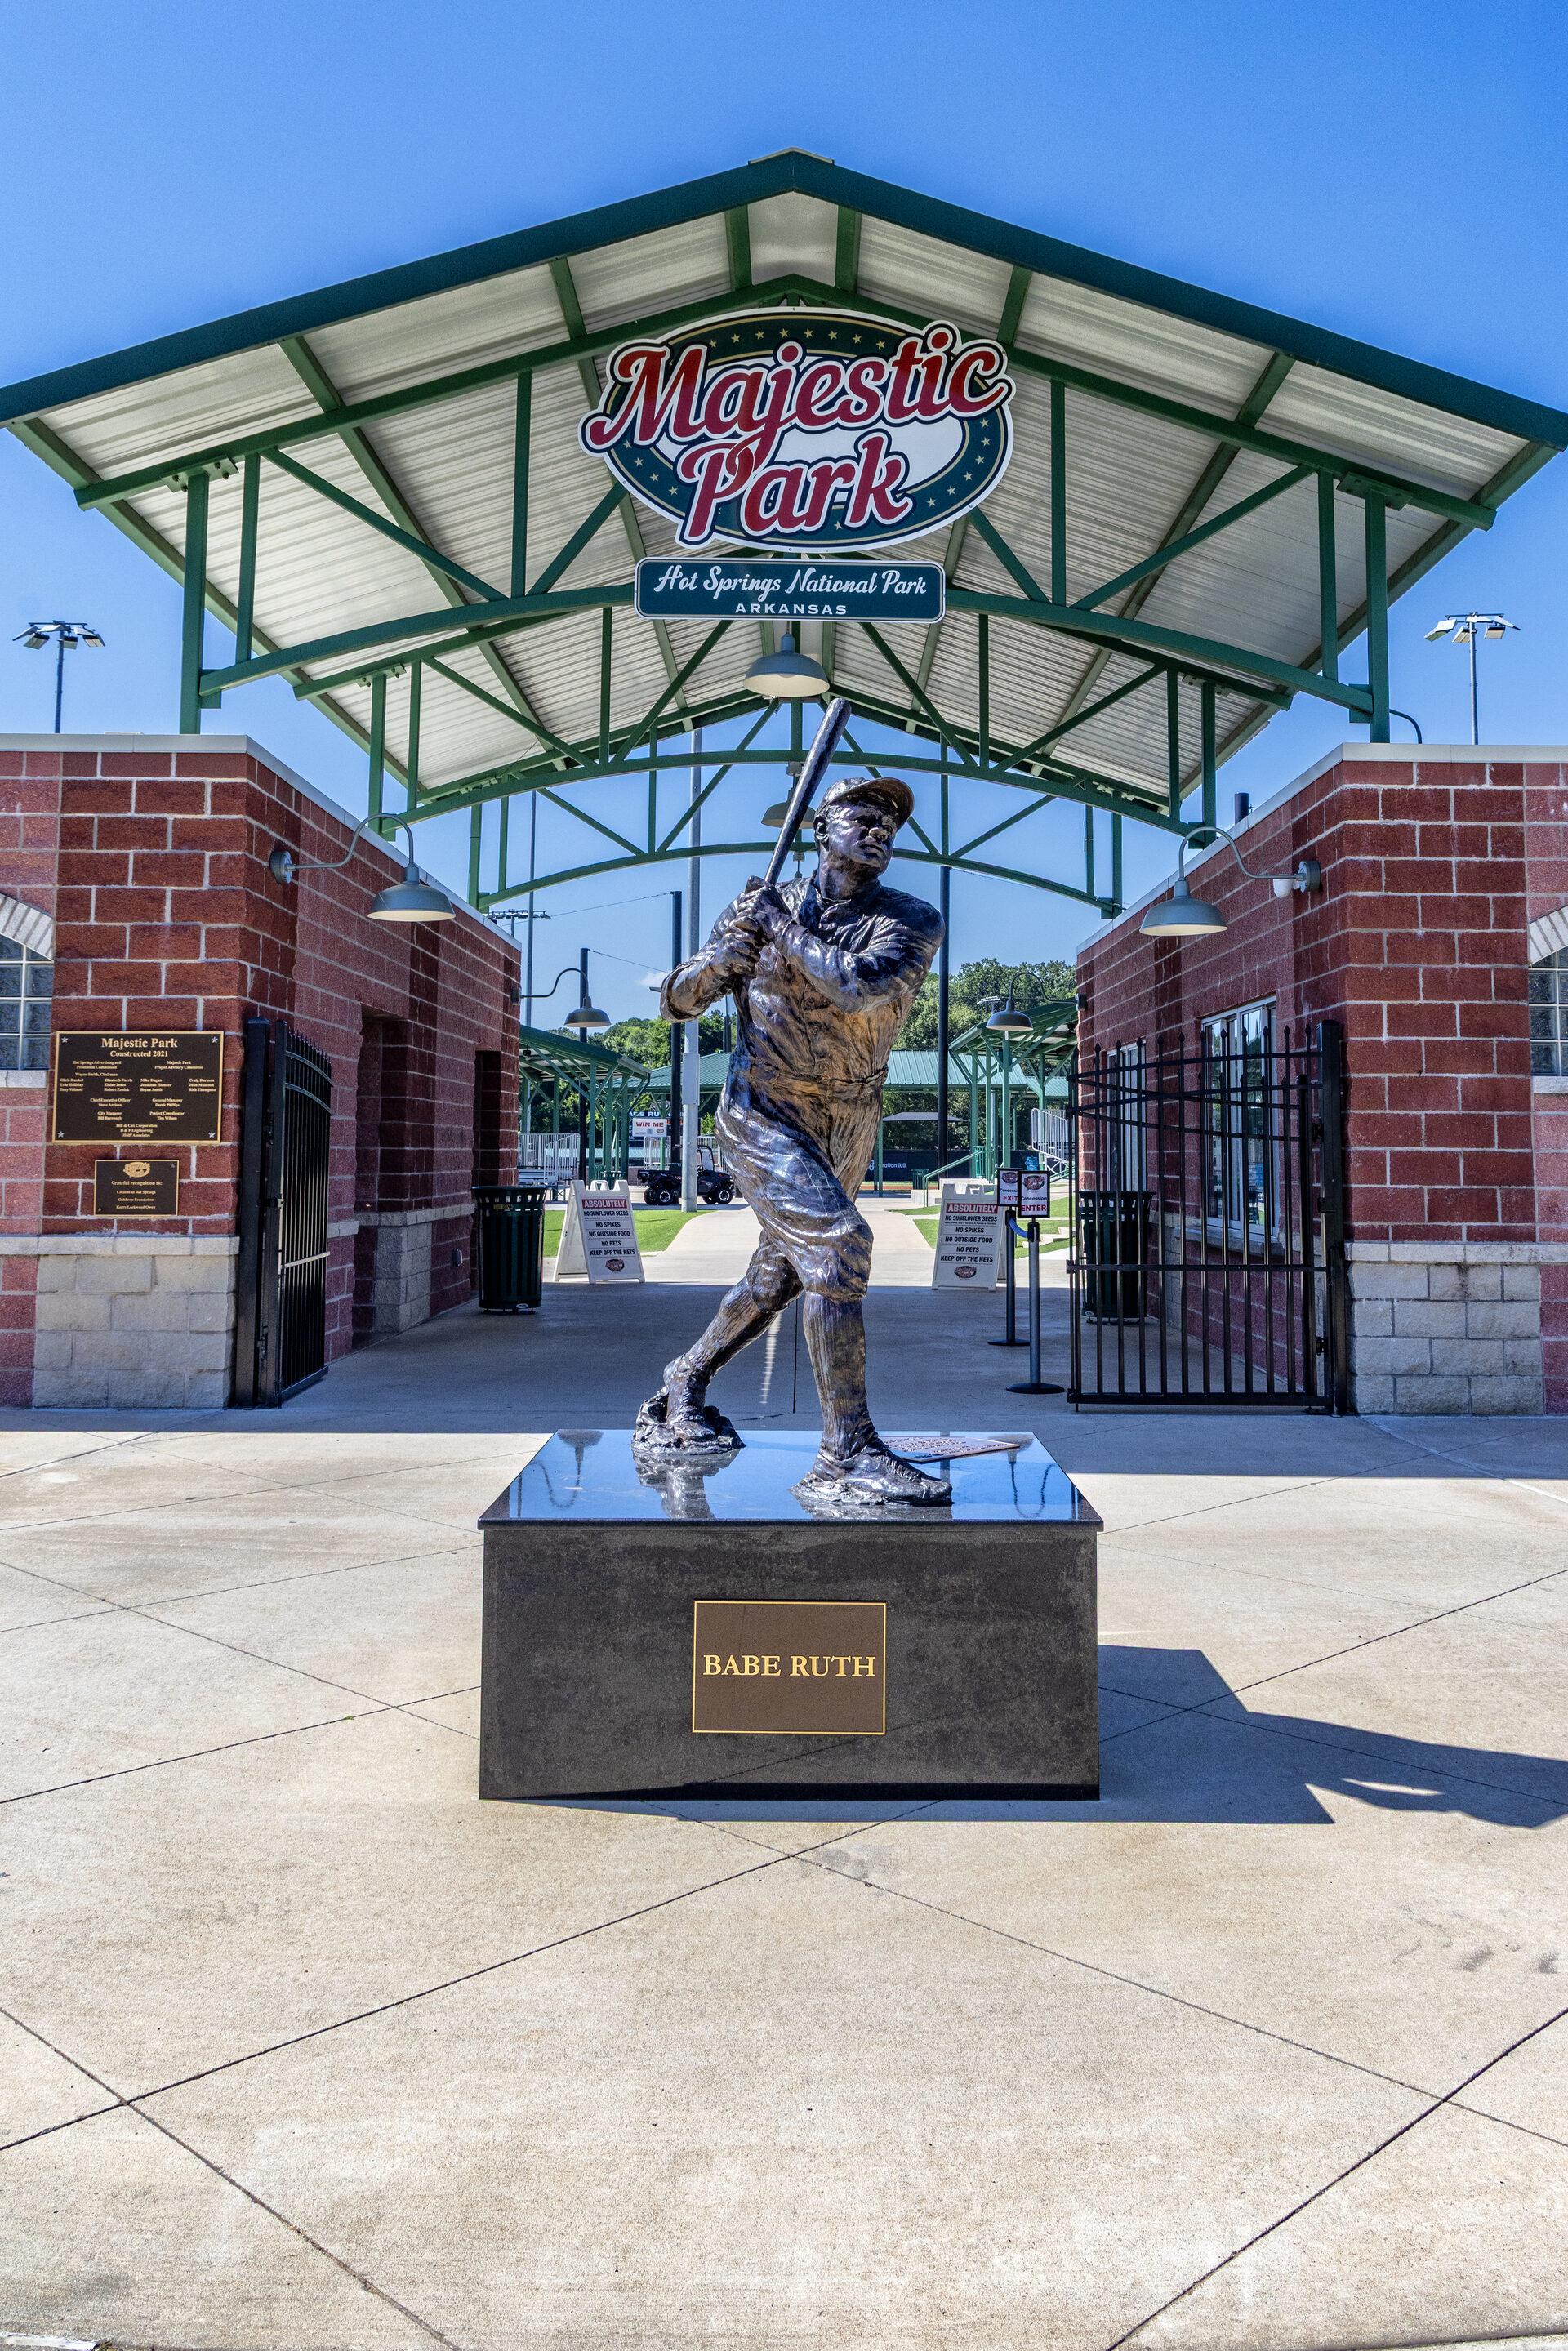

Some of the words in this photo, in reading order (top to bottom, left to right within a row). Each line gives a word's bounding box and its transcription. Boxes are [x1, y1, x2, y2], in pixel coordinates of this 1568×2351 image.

[586, 330, 1008, 478] Majestic
[676, 433, 911, 539] Park
[653, 564, 697, 593] Hot
[702, 565, 782, 603] Springs
[785, 567, 878, 594] National
[881, 570, 928, 595] Park
[735, 603, 847, 616] ARKANSAS
[101, 1037, 148, 1050] Majestic
[151, 1037, 178, 1048] Park
[948, 1204, 996, 1213] ABSOLUTELY
[702, 1654, 781, 1676] BABE
[789, 1654, 876, 1677] RUTH
